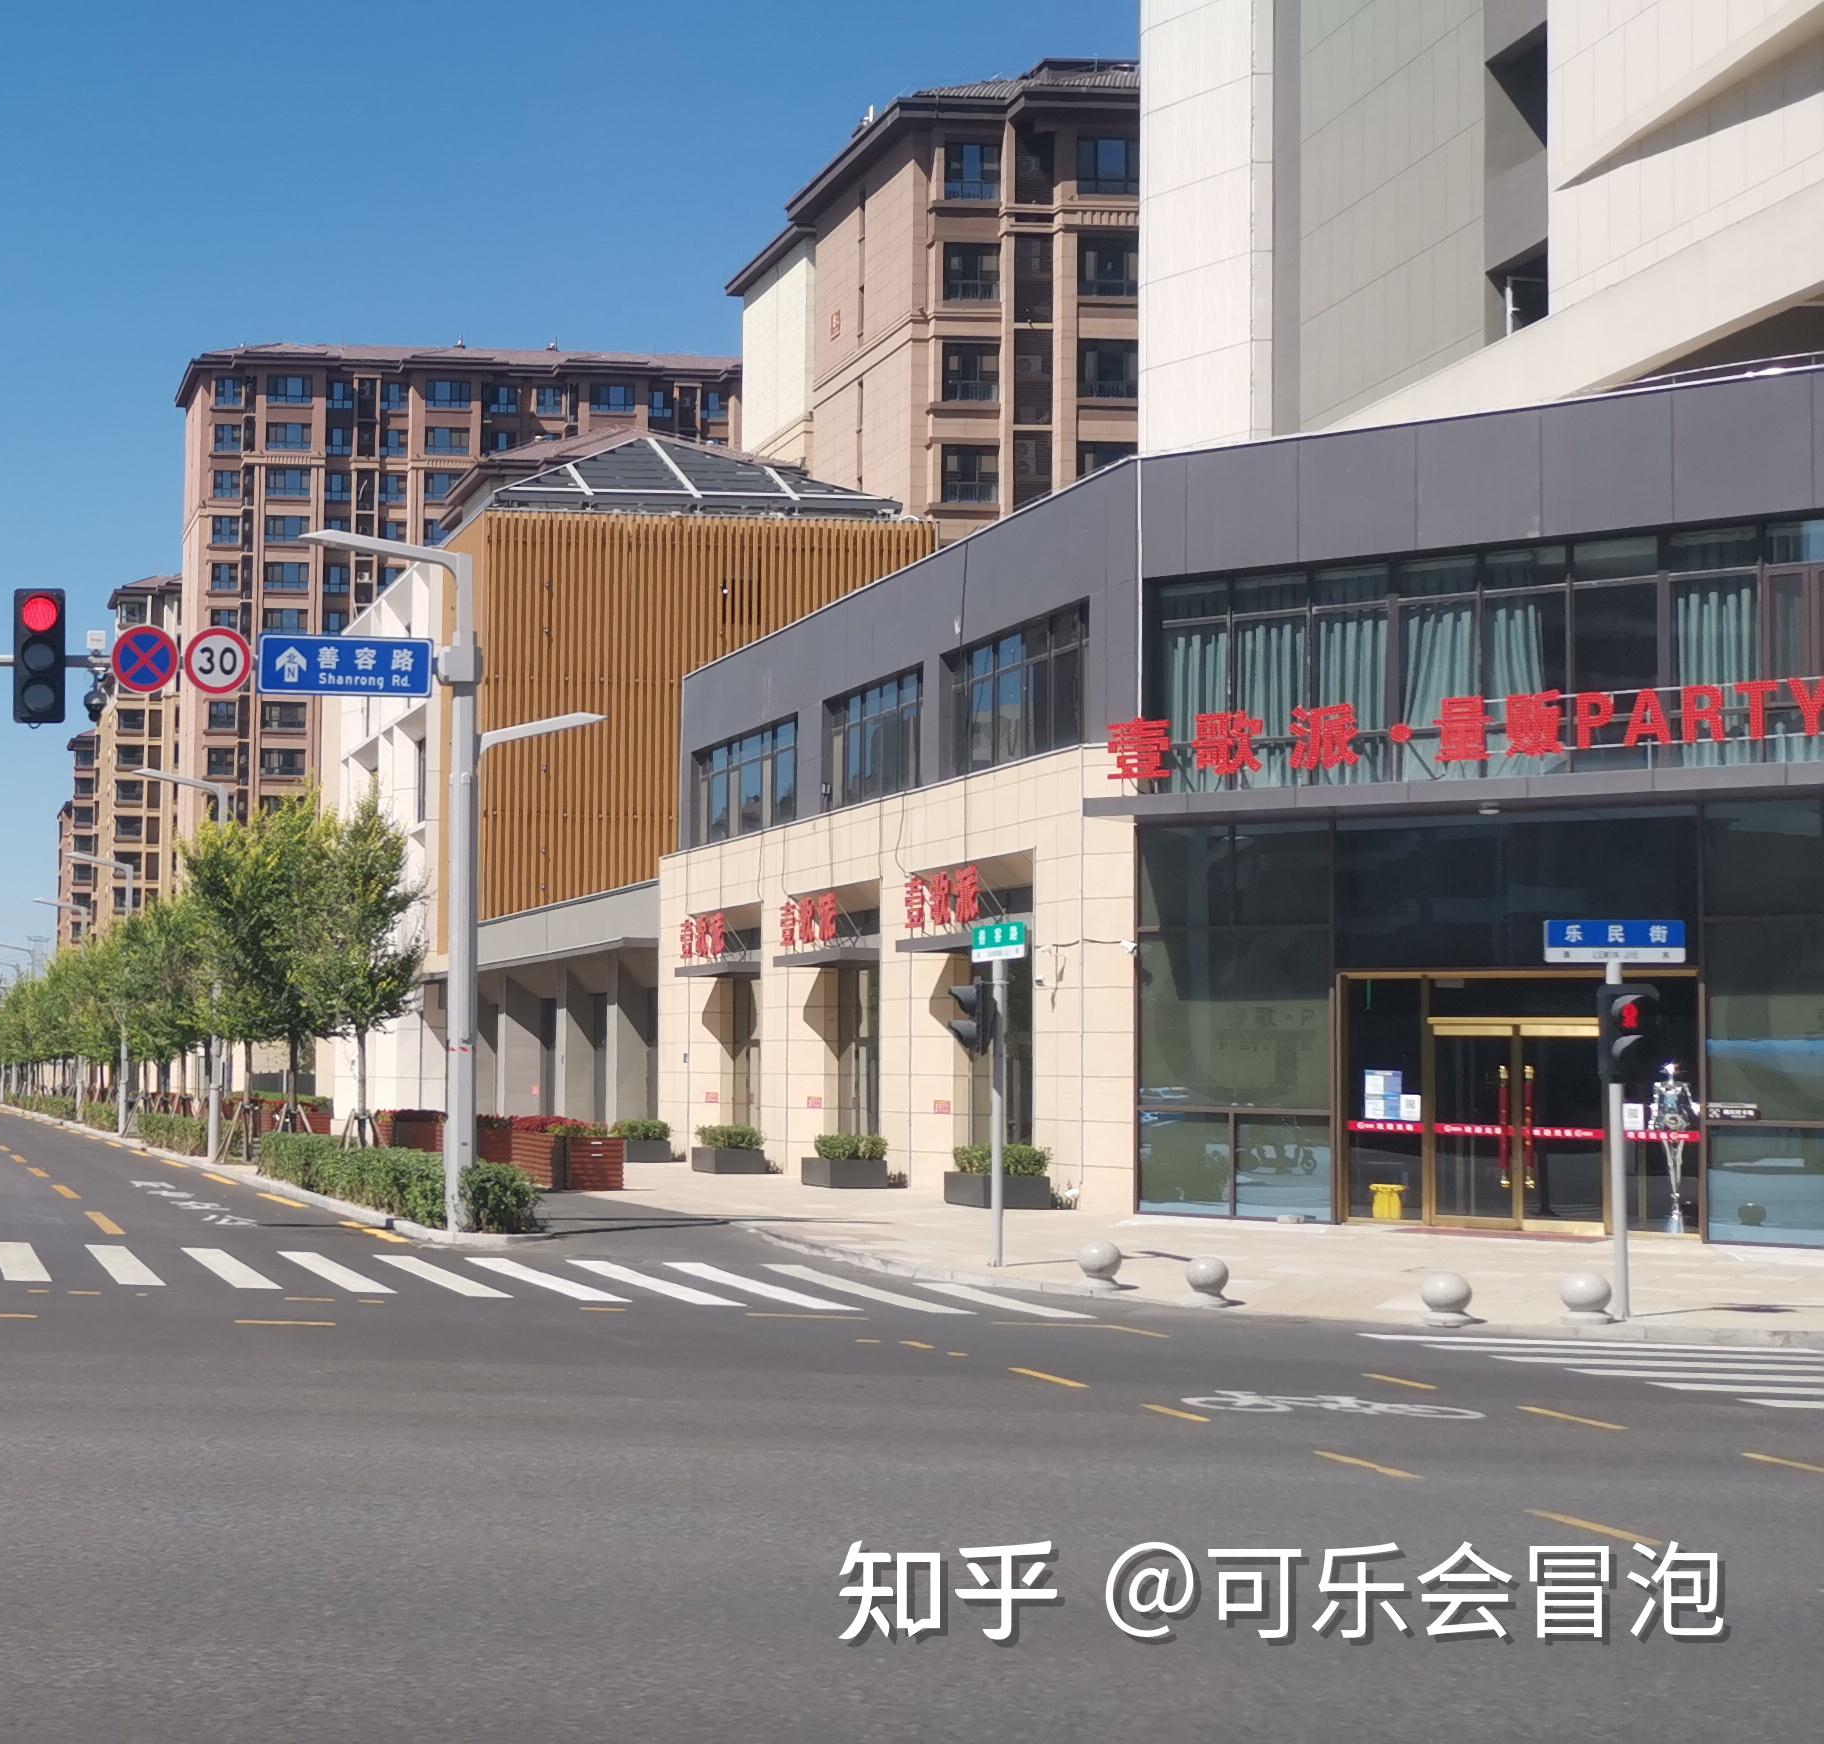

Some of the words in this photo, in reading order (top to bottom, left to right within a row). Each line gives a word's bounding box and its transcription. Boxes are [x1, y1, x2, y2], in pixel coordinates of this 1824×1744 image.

[198, 646, 237, 677] 30
[317, 646, 415, 672] 善容路
[287, 667, 296, 678] N
[318, 672, 385, 689] Shanrong
[391, 674, 412, 688] Rd.
[1564, 924, 1669, 943] 乐民街
